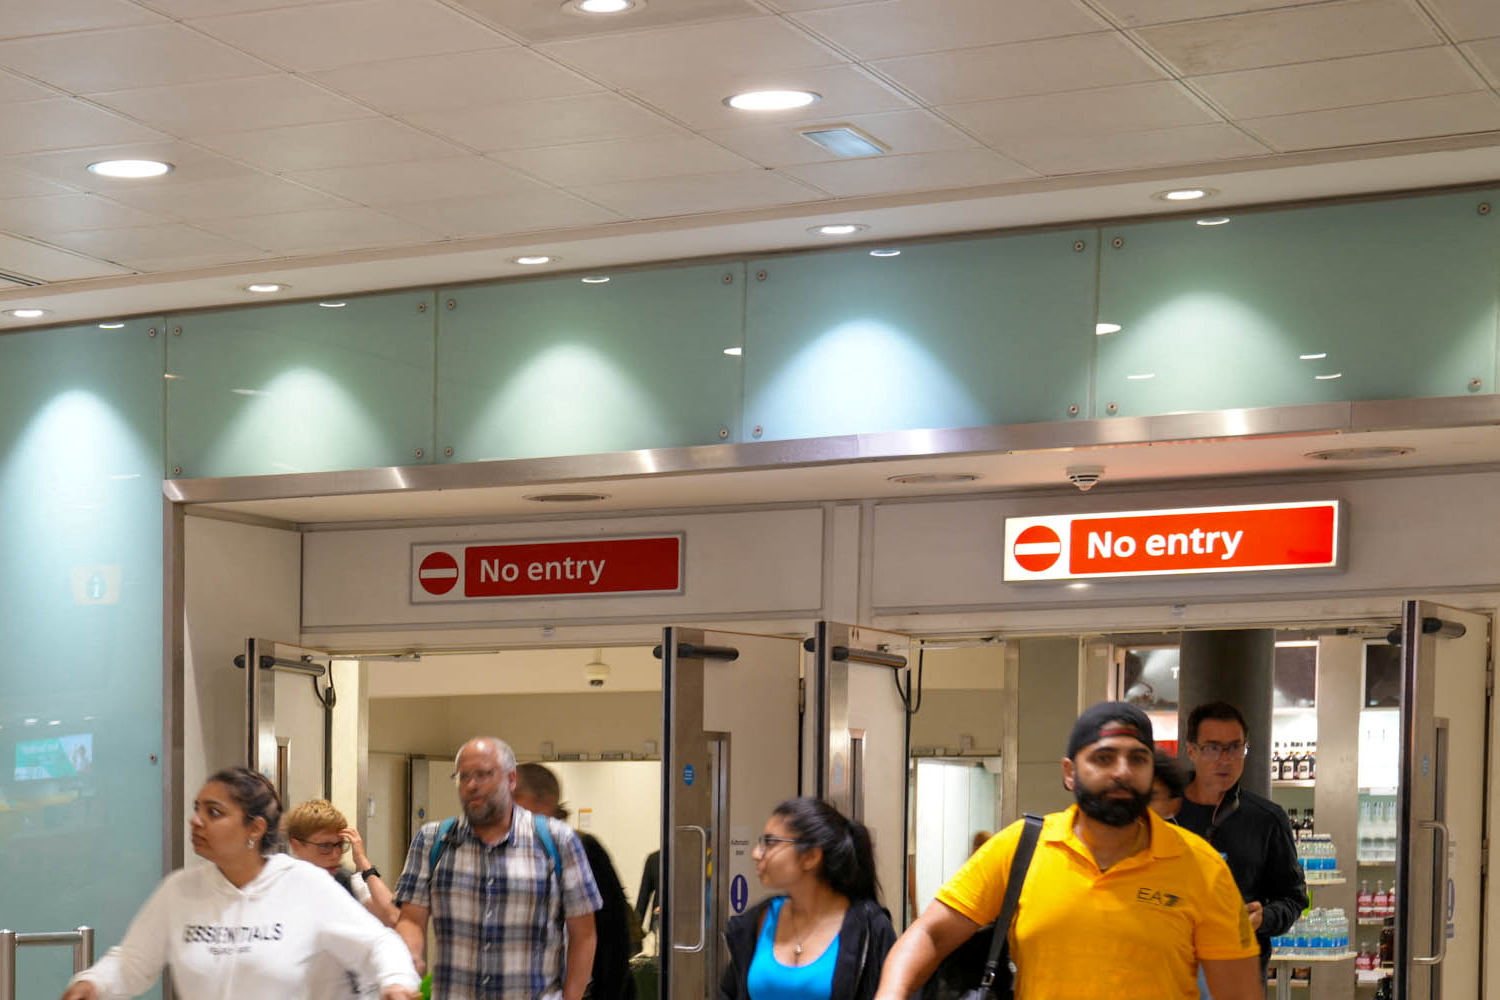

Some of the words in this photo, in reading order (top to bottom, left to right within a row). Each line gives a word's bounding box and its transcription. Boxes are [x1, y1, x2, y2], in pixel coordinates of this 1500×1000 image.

[1087, 531, 1137, 559] No
[1145, 528, 1244, 560] entry
[480, 558, 519, 583] No
[527, 556, 606, 585] entry
